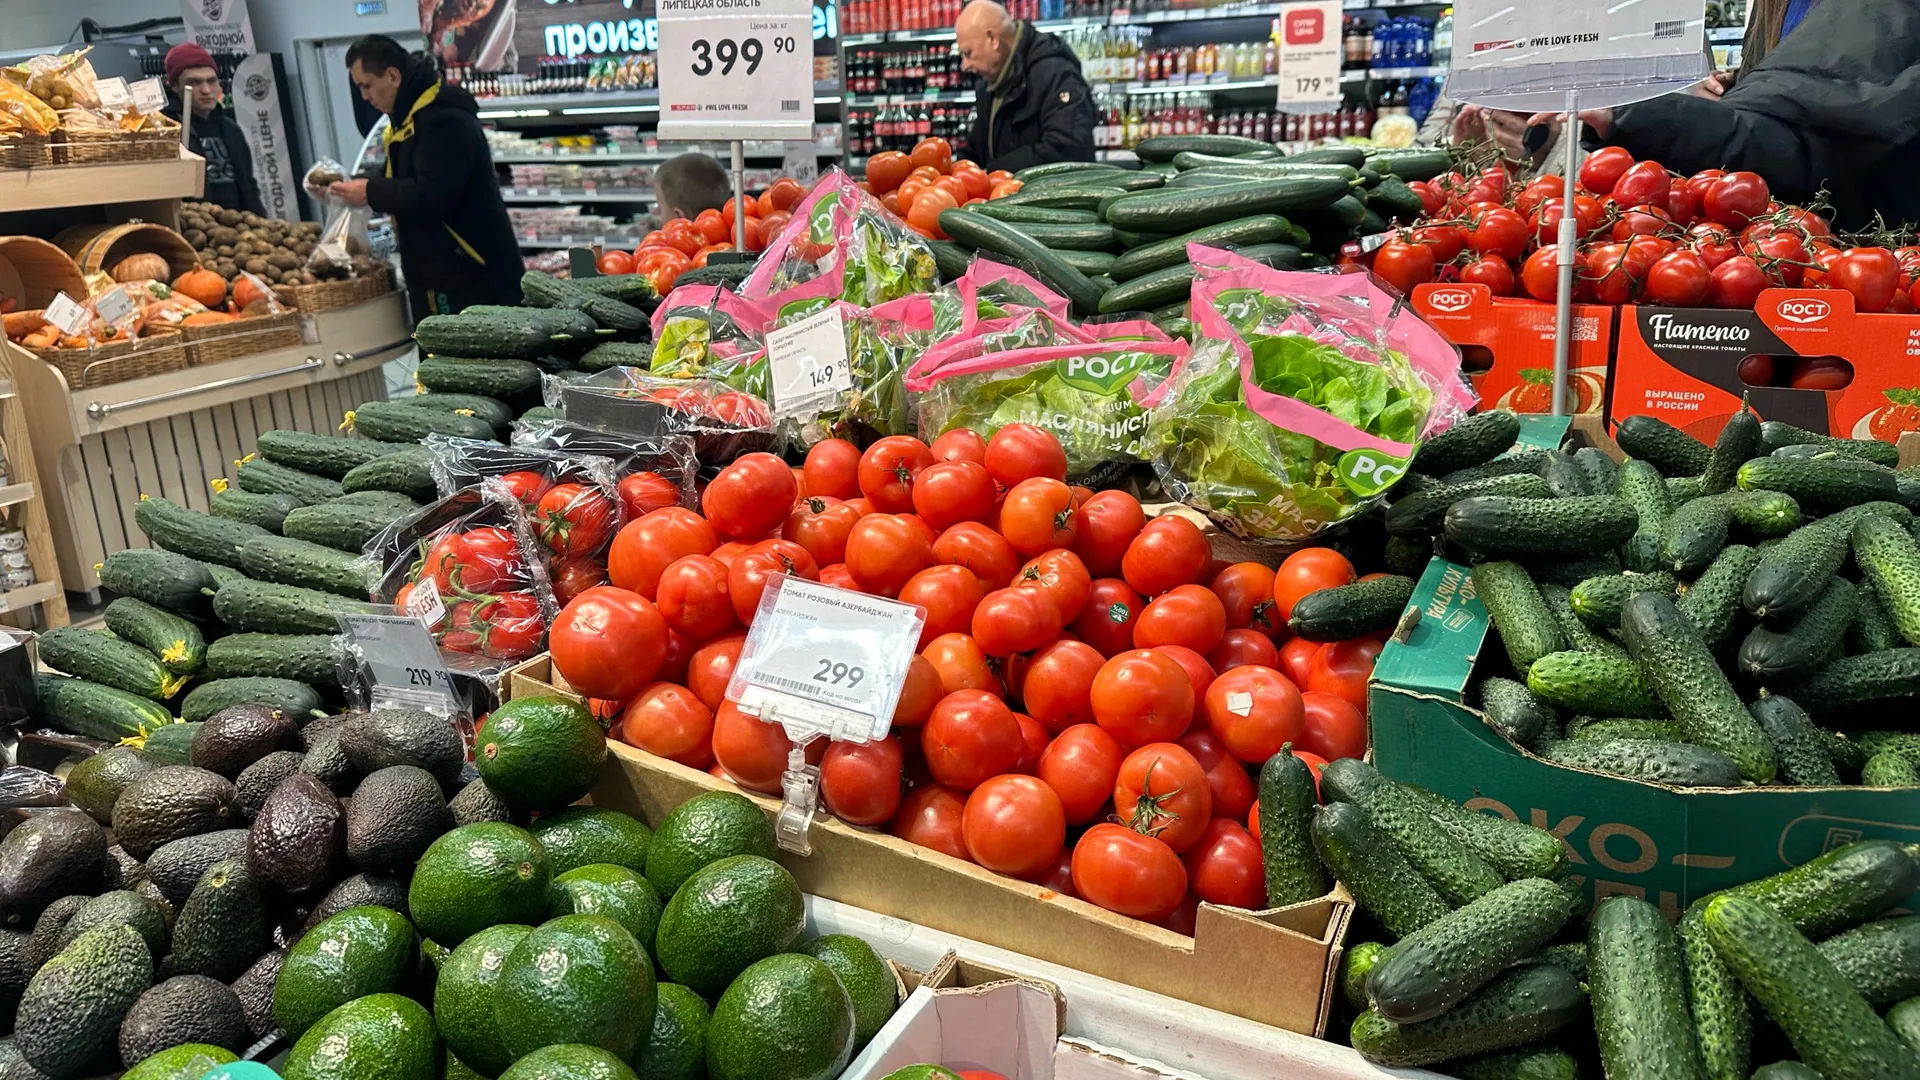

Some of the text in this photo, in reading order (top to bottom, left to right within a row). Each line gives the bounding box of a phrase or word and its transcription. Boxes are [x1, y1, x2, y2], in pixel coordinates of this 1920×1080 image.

[662, 0, 761, 10] ЛИПЕЦКАЯ ОБЛАСТЬ
[750, 22, 768, 30] Цена
[1530, 37, 1548, 47] #WE
[1551, 35, 1570, 45] LOVE
[1573, 33, 1599, 43] FRESH
[691, 36, 795, 76] 399 90
[1296, 78, 1320, 93] 179
[257, 109, 274, 149] ЦЕНЕ
[1433, 294, 1468, 304] РОСТ
[1783, 303, 1826, 315] РОСТ
[1649, 314, 1750, 341] Flamenco
[809, 358, 848, 388] 149 90
[1068, 352, 1145, 377] РОСТ
[1645, 390, 1705, 401] ВЫРАЩЕНО
[1656, 402, 1699, 411] РОССИИ
[1425, 566, 1463, 619] КУЛЬТУРА
[783, 588, 893, 619] ТОМАТ РОЗОВЫЙ АЗЕРБАЙДЖАН
[406, 667, 447, 686] 219 90
[813, 658, 864, 689] 299
[822, 689, 834, 698] Код
